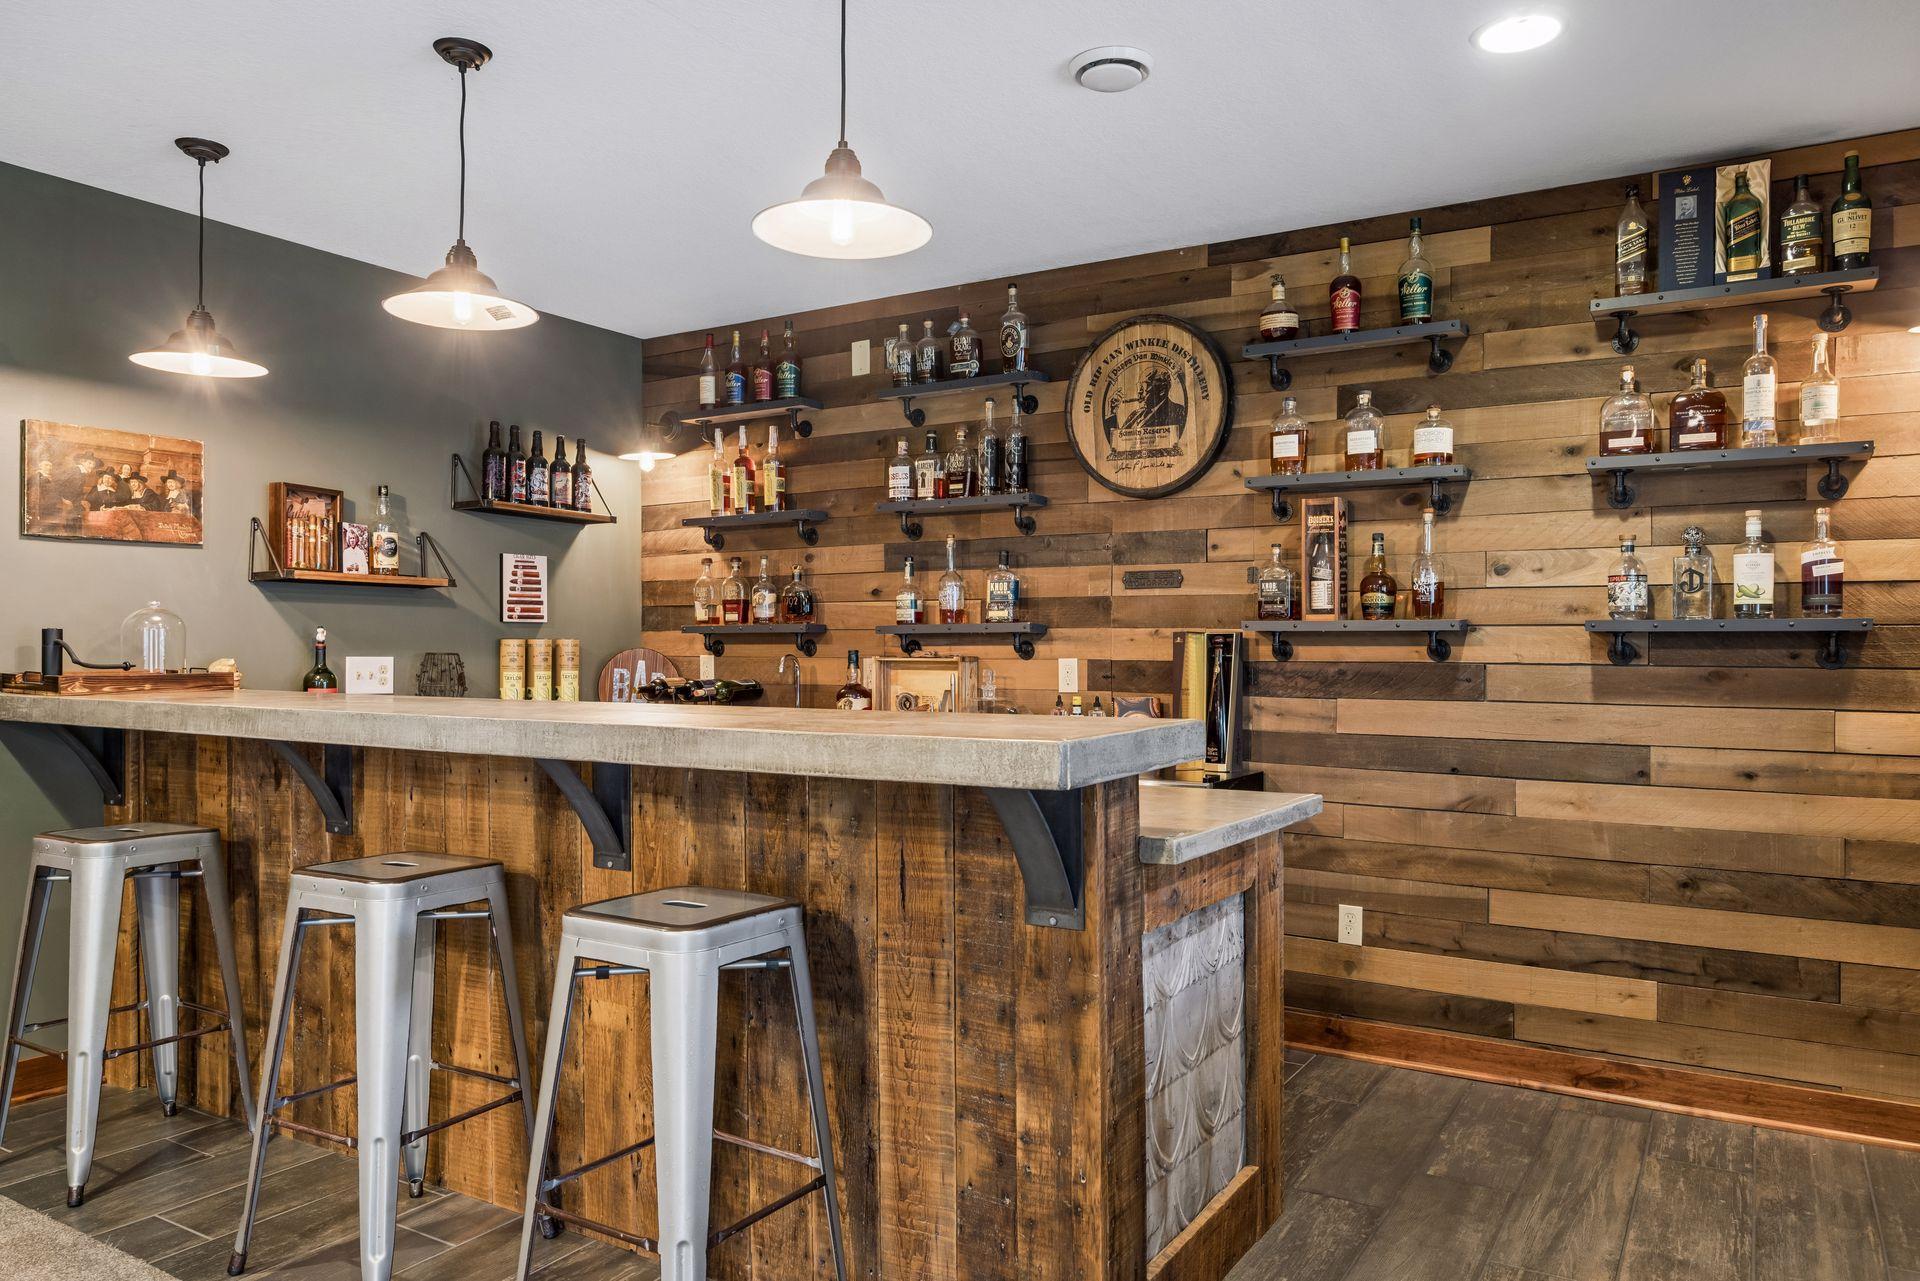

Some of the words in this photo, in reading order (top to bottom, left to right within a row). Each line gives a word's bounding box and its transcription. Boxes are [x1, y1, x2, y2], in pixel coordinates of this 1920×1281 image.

[1783, 216, 1815, 227] TULLAMORE
[1618, 243, 1632, 251] LACK
[1133, 353, 1148, 361] Van
[1083, 391, 1093, 414] OLD
[1090, 366, 1103, 388] RIP
[1103, 348, 1123, 365] VAN
[1125, 337, 1170, 350] WINKLE
[1171, 343, 1210, 401] DISTILLERY
[990, 582, 1008, 591] KNOB
